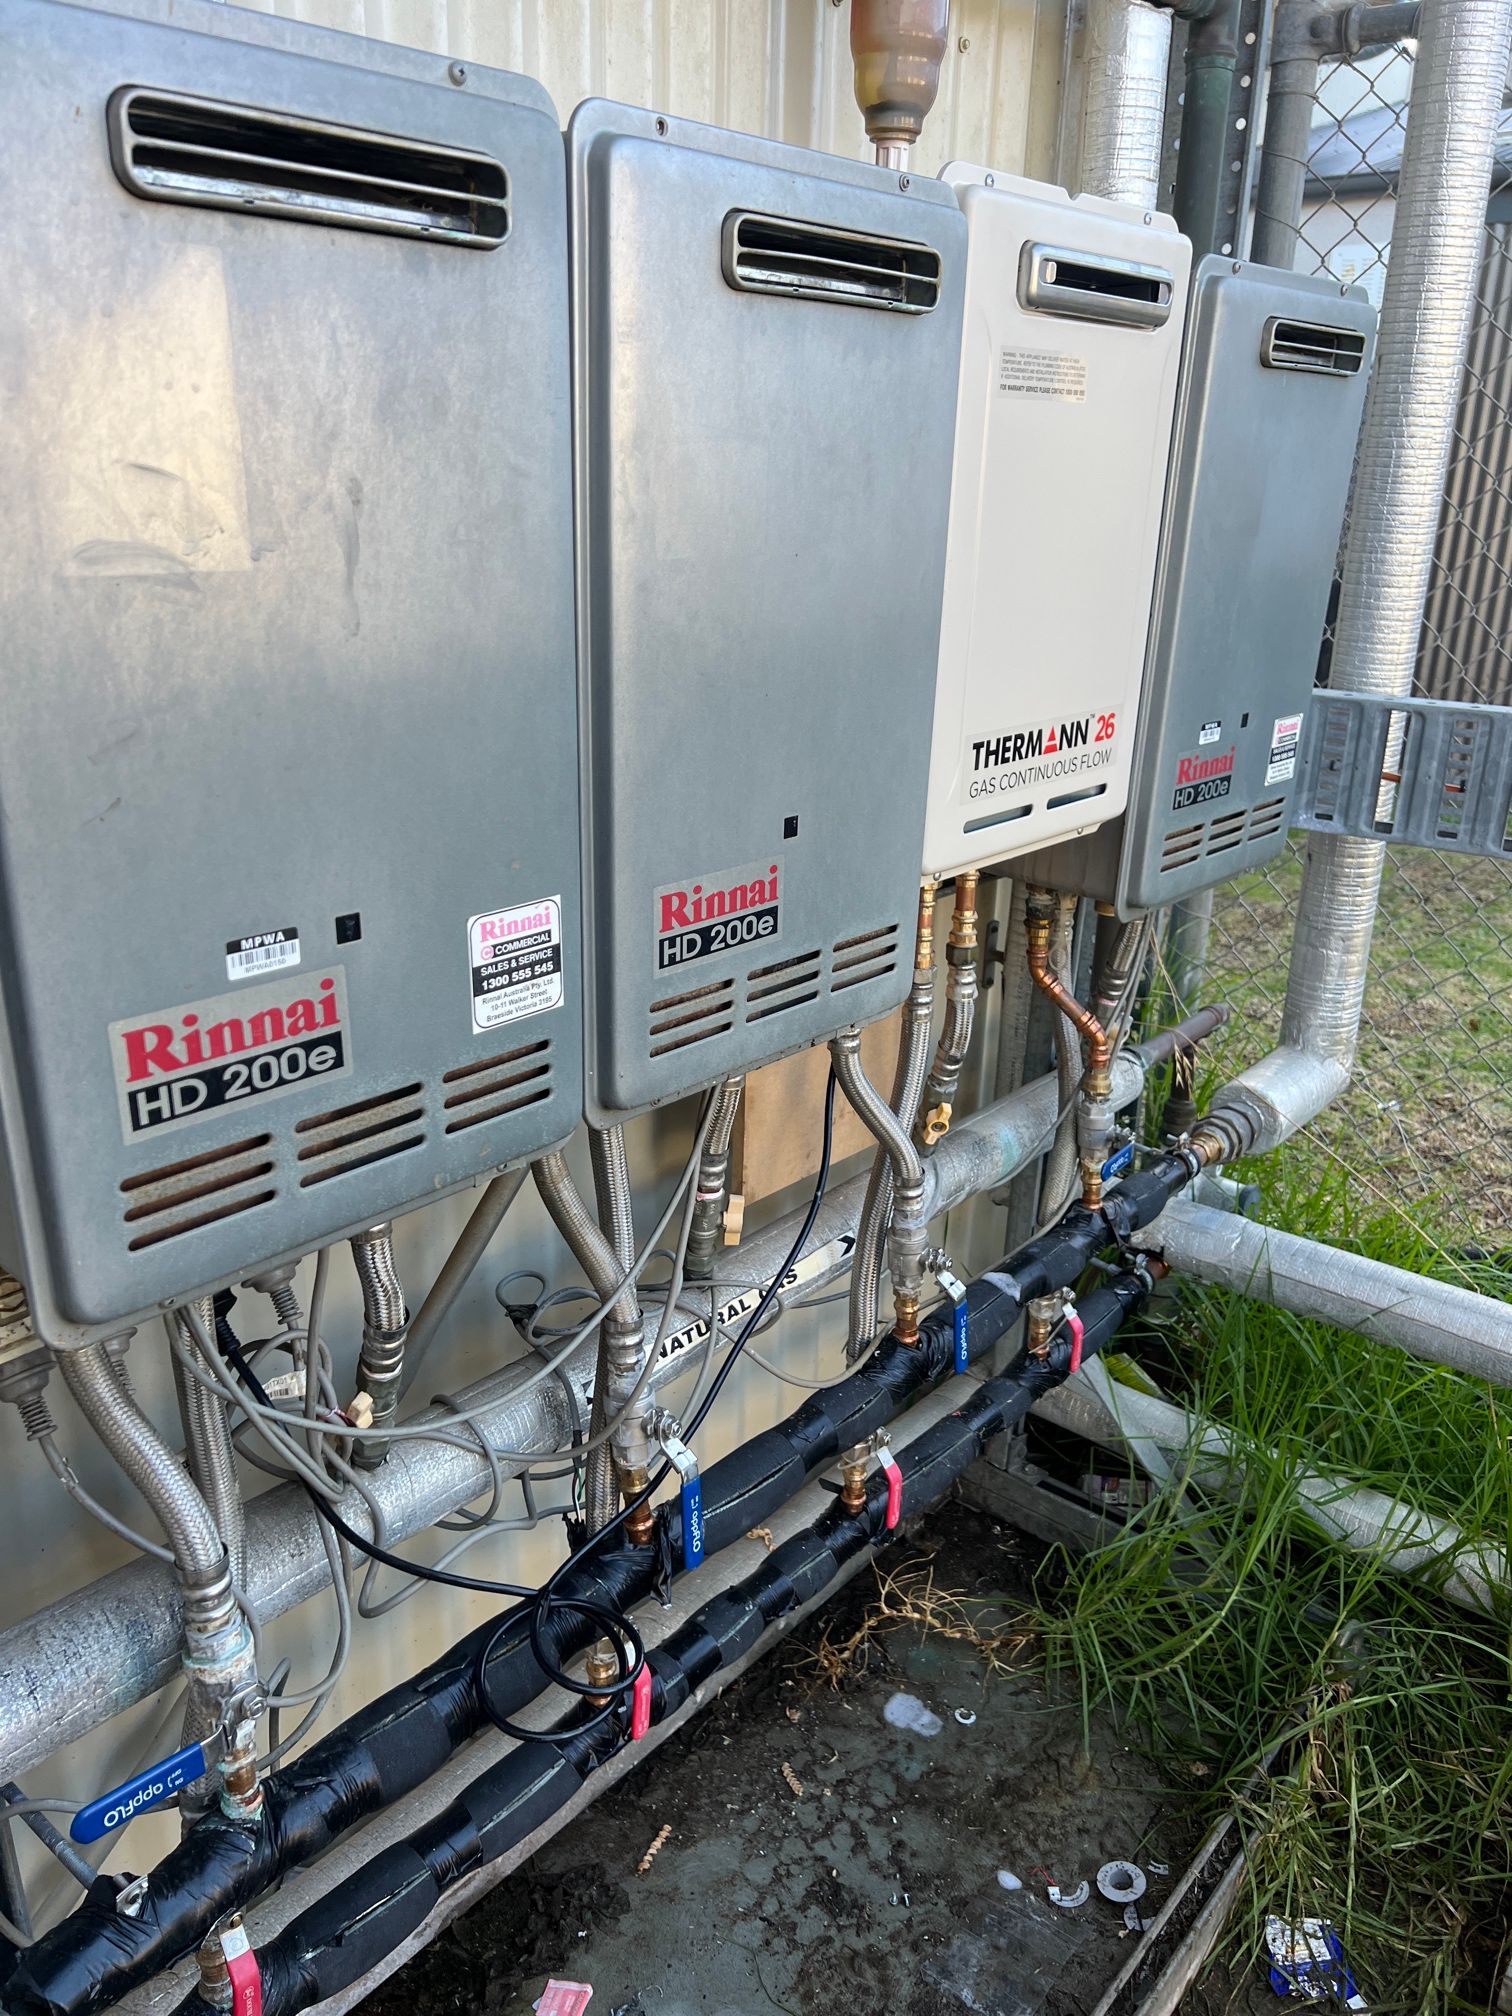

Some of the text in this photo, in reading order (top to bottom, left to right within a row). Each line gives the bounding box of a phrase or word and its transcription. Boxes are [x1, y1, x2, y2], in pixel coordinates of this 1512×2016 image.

[1094, 712, 1116, 742] 26
[969, 747, 1112, 799] GAS CONTINUOUS FLOW
[1176, 745, 1235, 785] Rinnai
[1174, 779, 1229, 809] HD 200e
[659, 864, 779, 934] Rinnai
[240, 930, 286, 951] MPWA
[480, 905, 552, 943] Rinnai
[663, 915, 775, 966] HD 200e
[495, 931, 551, 955] COMMERCIAL
[480, 947, 554, 977] SALES & SERVICE
[481, 960, 554, 991] 1300 555 545
[482, 991, 503, 1005] Rinnai
[503, 985, 530, 999] Australia
[486, 1009, 514, 1022] Braeside
[514, 1002, 538, 1014] Victoria
[508, 994, 530, 1006] Walker
[530, 988, 549, 999] Street
[121, 977, 341, 1083] Rinnai
[136, 1044, 338, 1126] HD 200e
[690, 1510, 701, 1553] appFLO
[103, 1783, 164, 1827] appFLO
